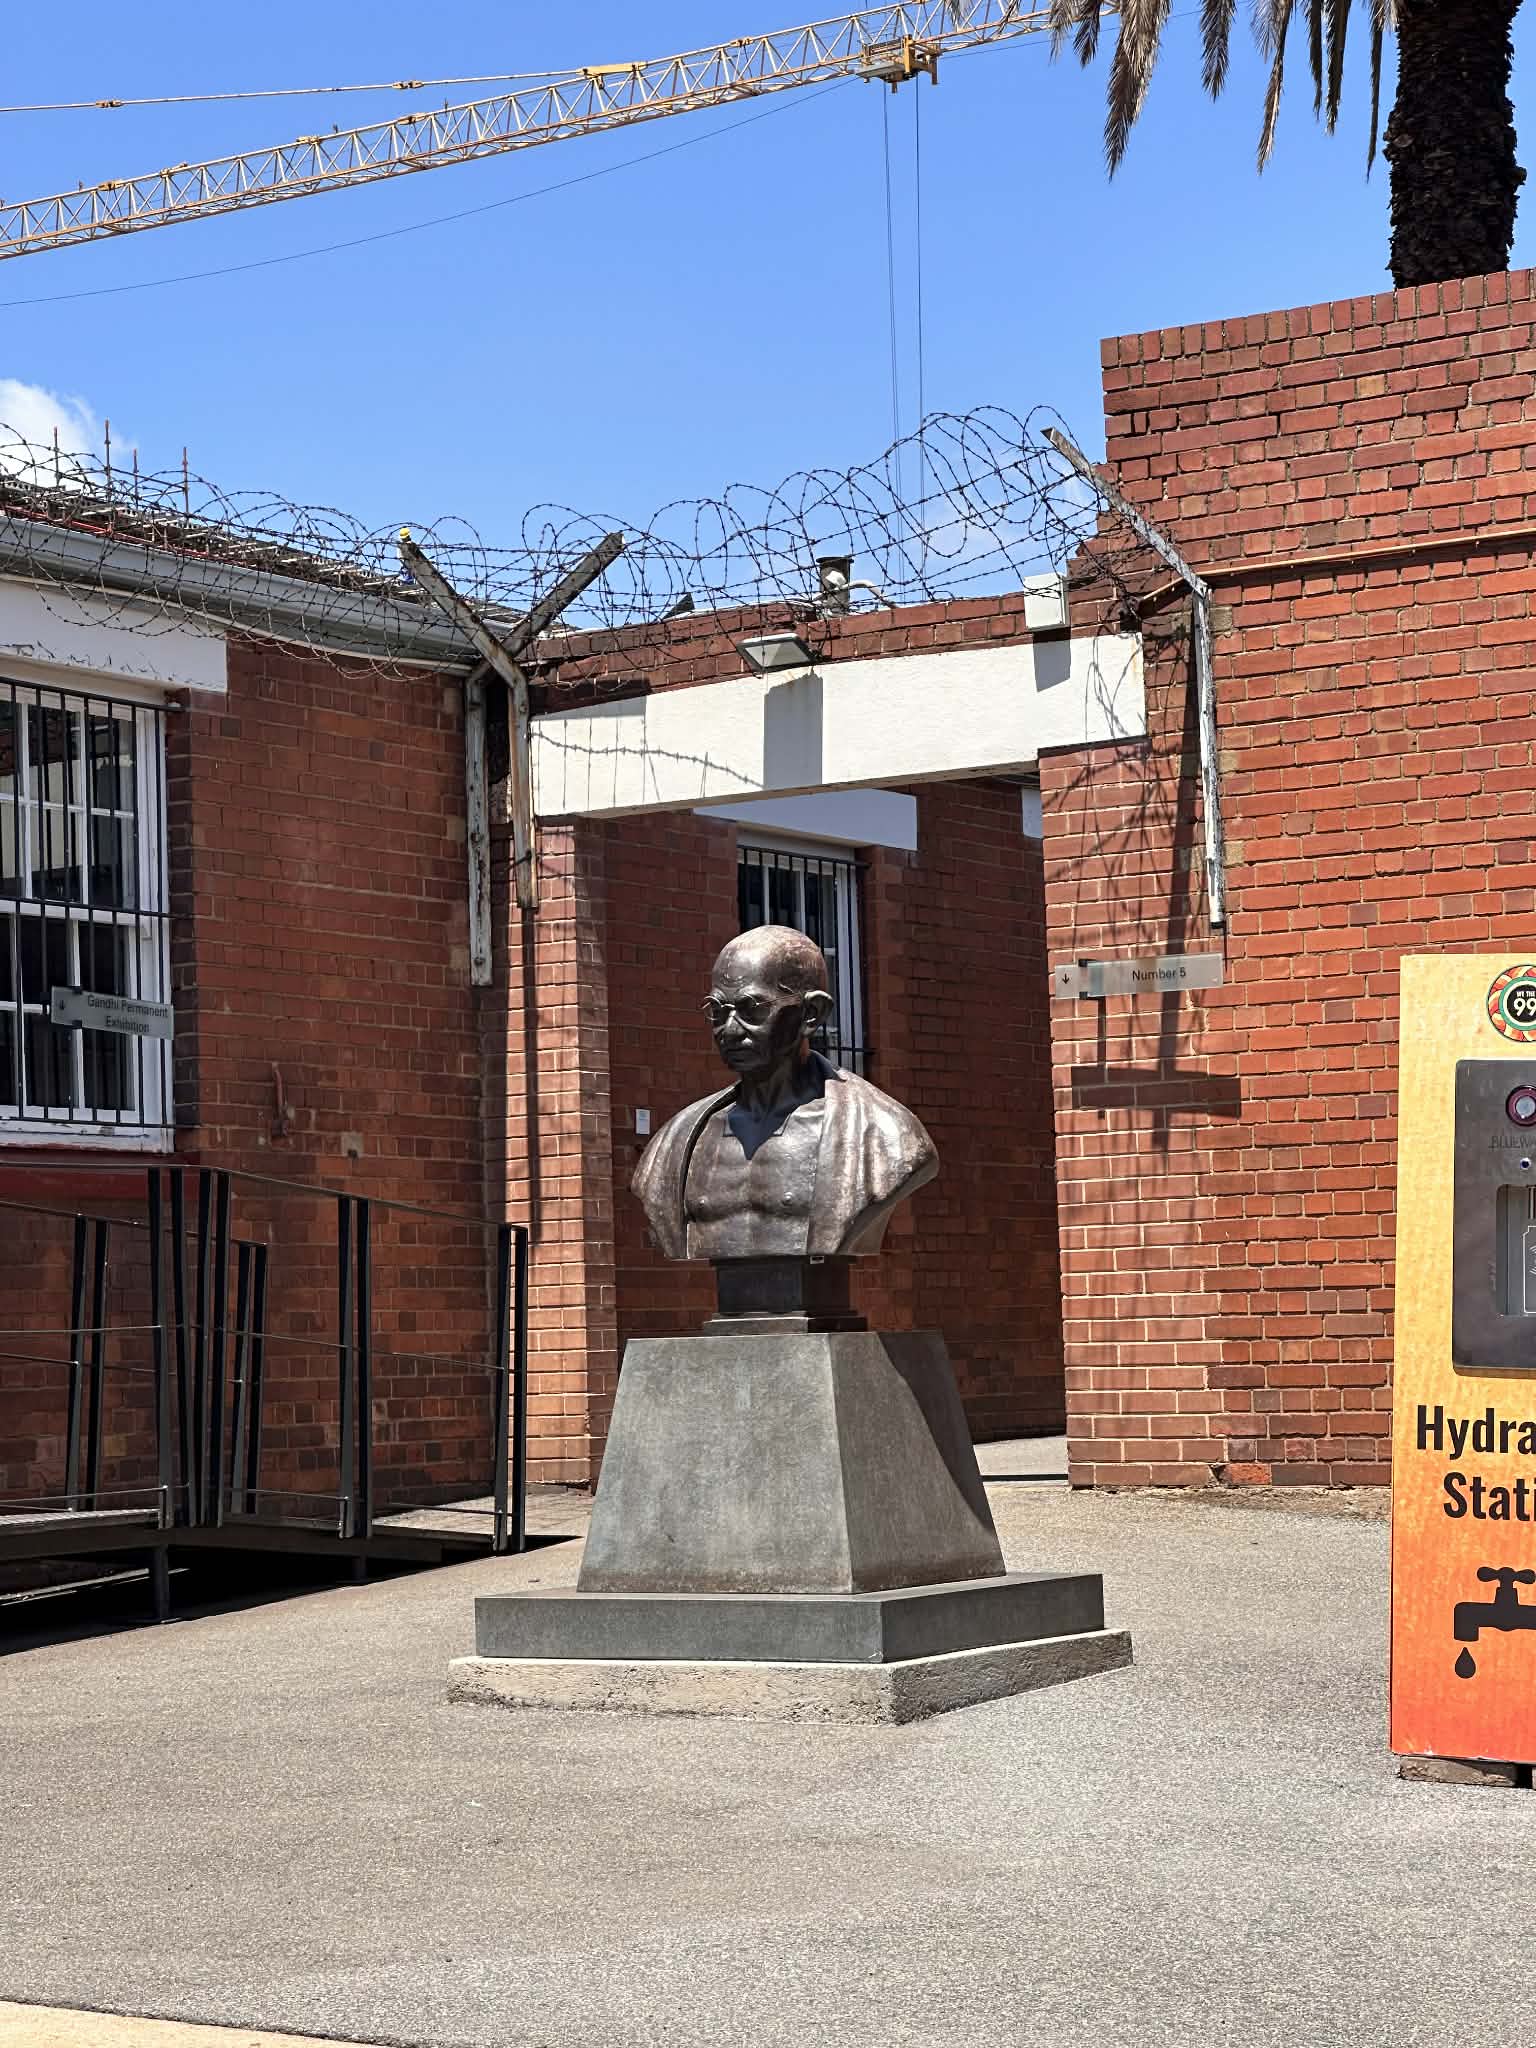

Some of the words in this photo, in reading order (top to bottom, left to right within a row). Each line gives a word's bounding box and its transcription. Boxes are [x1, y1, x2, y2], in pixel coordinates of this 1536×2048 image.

[1132, 967, 1177, 981] Number
[1179, 966, 1186, 977] 5
[87, 994, 119, 1009] Gandhi
[121, 1000, 168, 1018] Permanent
[105, 1015, 150, 1033] Exhibition
[1416, 1404, 1536, 1460] Hydra
[1443, 1471, 1536, 1521] Stat
